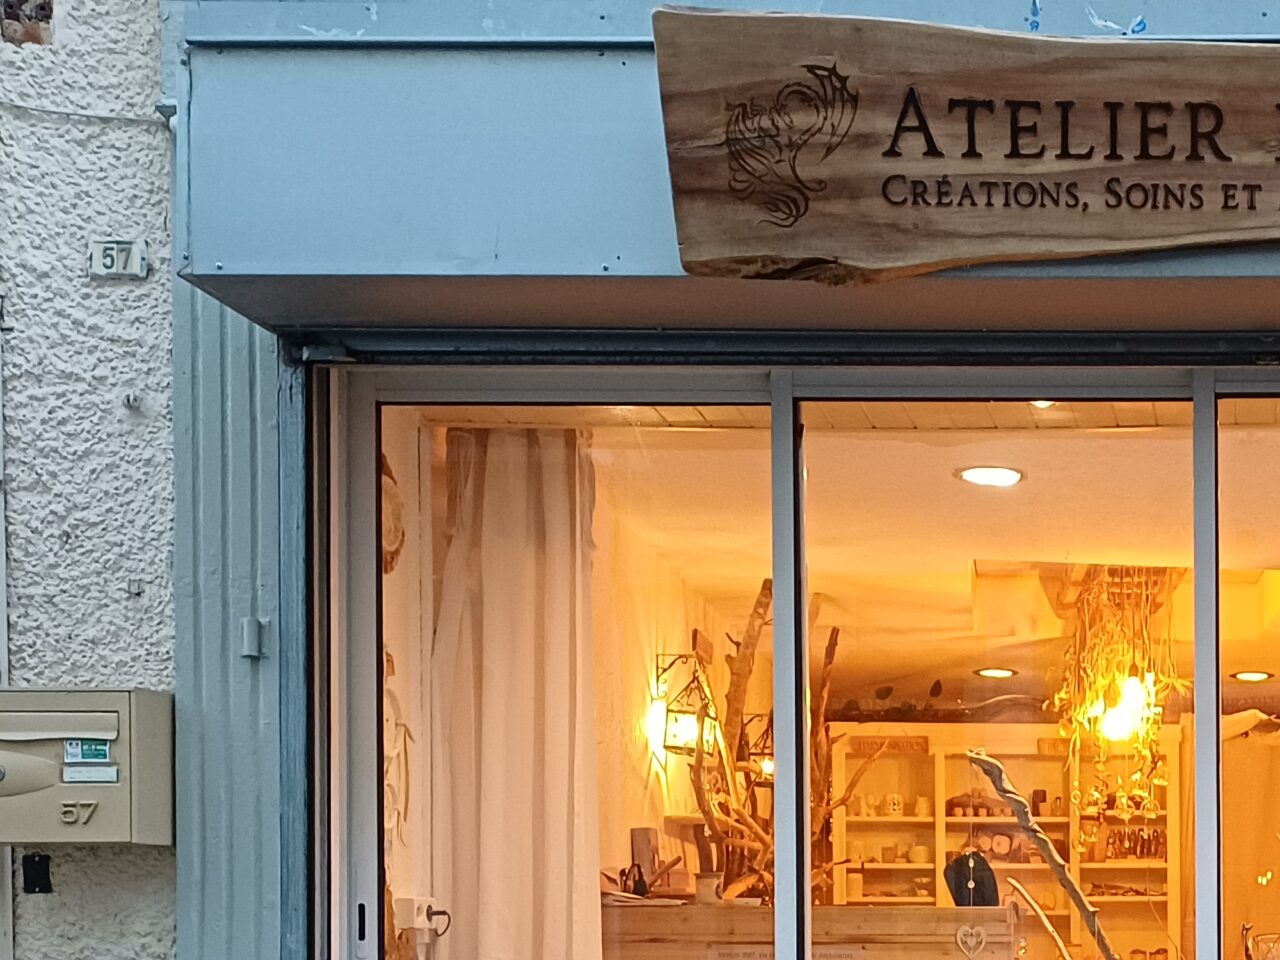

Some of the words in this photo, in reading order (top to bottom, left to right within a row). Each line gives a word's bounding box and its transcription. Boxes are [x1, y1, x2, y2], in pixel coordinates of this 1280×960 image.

[880, 84, 1233, 162] ATELIER
[880, 174, 1089, 213] CRÉATIONS,
[1104, 176, 1204, 210] SOINS
[1220, 184, 1263, 210] ET
[102, 245, 132, 270] 57
[60, 800, 99, 826] 57
